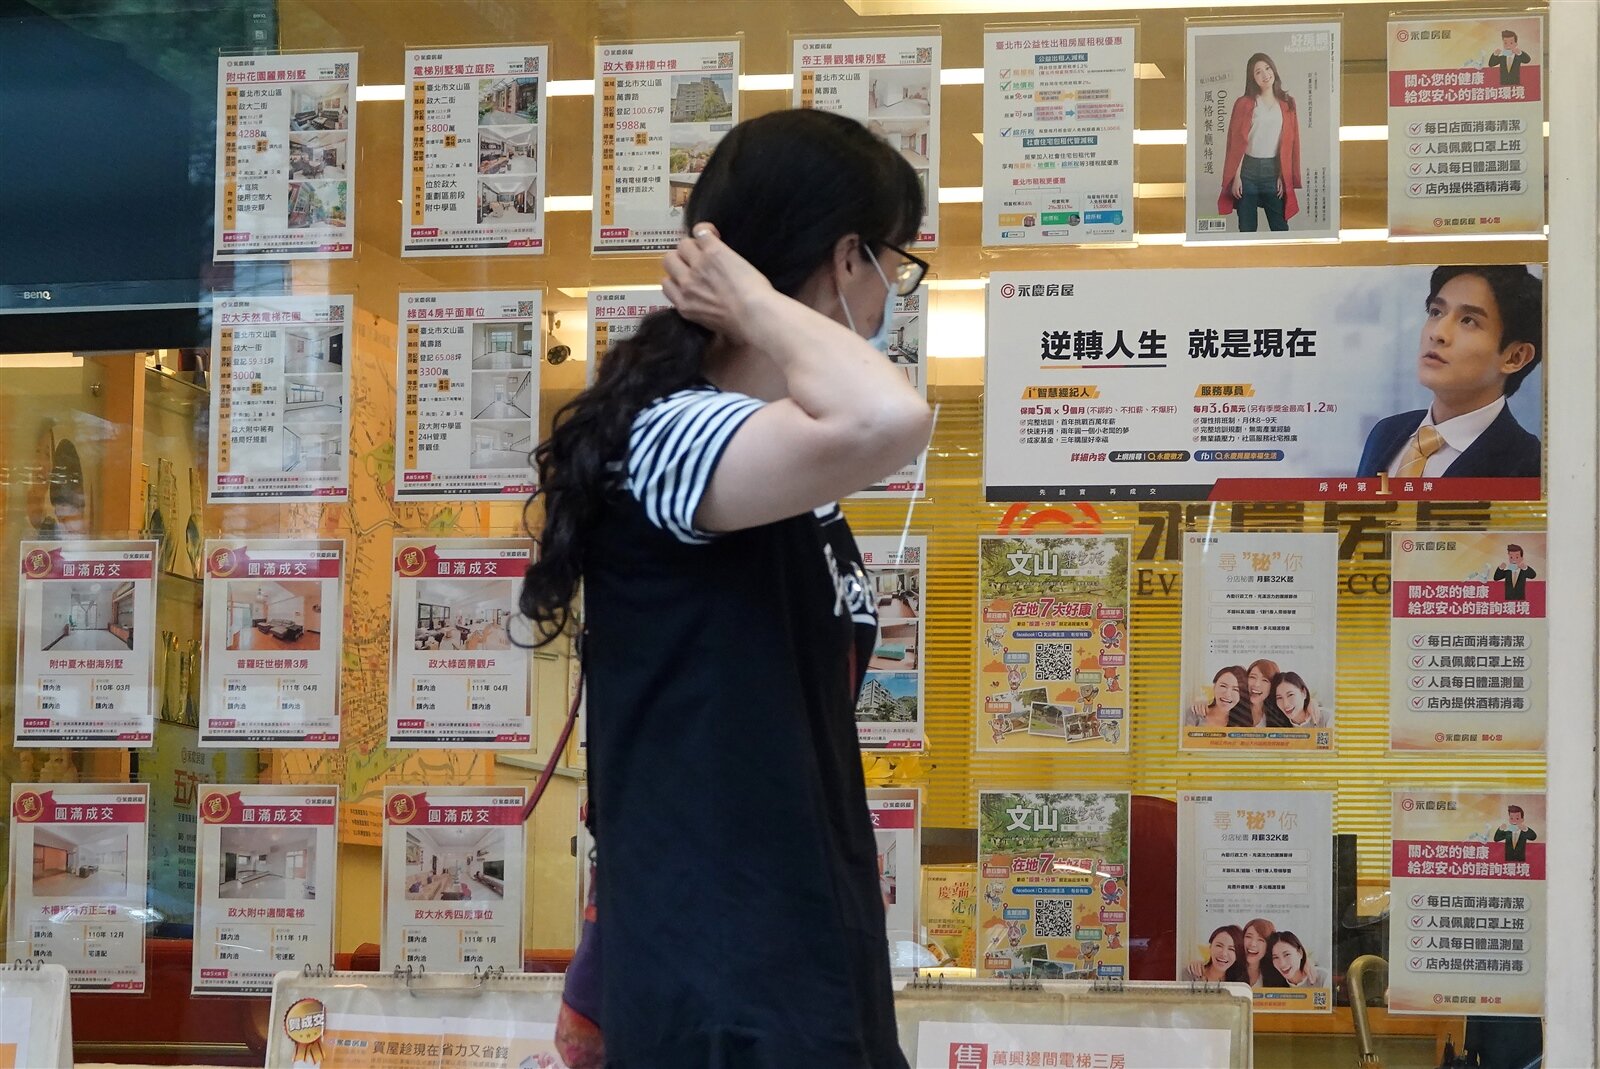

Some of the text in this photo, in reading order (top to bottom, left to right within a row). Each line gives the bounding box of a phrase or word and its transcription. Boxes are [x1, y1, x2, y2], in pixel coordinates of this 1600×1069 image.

[1410, 30, 1451, 40] 永慶房屋
[996, 36, 1122, 50] 臺北市公益性出租房屋租稅優惠
[802, 53, 886, 65] 帝王景觀獨棟別墅
[414, 64, 494, 76] 電梯別墅獨立庭院
[604, 60, 677, 71] 政大春耕樓中樓
[226, 70, 306, 82] 附中花園麗景別墅
[1404, 72, 1484, 87] 關心您的健康
[427, 83, 470, 92] 臺北市文山區
[617, 79, 662, 88] 臺北市文山區
[239, 88, 282, 98] 臺北市文山區
[1404, 86, 1526, 104] 給您安心的諮詢環境
[238, 102, 268, 110] 政大二街
[1217, 90, 1228, 132] Outdoor
[426, 124, 455, 132] 5800萬
[616, 121, 646, 130] 5988萬
[1424, 120, 1520, 134] 每日店面消毒清潔
[238, 129, 267, 138] 4288萬
[1203, 91, 1214, 174] 風格餐廳特選
[1426, 140, 1520, 154] 人員佩戴口罩上班
[1426, 160, 1520, 174] 人員每日體溫測量
[426, 180, 458, 188] 位於政大
[1426, 180, 1521, 194] 店內提供酒精消毒
[426, 192, 466, 200] 重劃區前段
[237, 204, 265, 212] 環境安靜
[425, 204, 457, 212] 附中學區
[24, 291, 51, 300] BenQ
[1018, 284, 1074, 298] 永慶房屋
[221, 311, 301, 323] 政大天然電梯花園
[408, 308, 485, 319] 綠茵4房平面車位
[420, 326, 464, 334] 臺北市文山區
[420, 340, 442, 348] 萬壽路
[1041, 328, 1317, 360] 逆轉人生 就是現在
[233, 371, 261, 380] 3000萬
[420, 368, 448, 376] 3300萬
[1202, 386, 1244, 396] 服務專員
[1020, 404, 1051, 415] 保障5萬
[231, 436, 267, 444] 格局好規劃
[1070, 453, 1106, 462] 詳細內容
[1201, 452, 1210, 460] fb
[1416, 542, 1456, 551] 永慶房屋
[32, 556, 120, 576] 賀 圓滿成交
[248, 562, 307, 576] 圓滿成交
[404, 552, 498, 575] 賀 圓滿成交
[1007, 550, 1058, 576] 文山
[1408, 586, 1489, 598] 關心您的健康
[1013, 598, 1092, 618] 在地7大好康
[1408, 602, 1530, 616] 給您安心的諮詢環境
[1428, 636, 1524, 647] 每日店面消毒清潔
[50, 659, 124, 670] 附中夏木樹海別墅
[237, 659, 308, 670] 普羅旺世樹景3房
[428, 659, 496, 670] 政大綠茵景觀戶
[1428, 656, 1524, 668] 人員佩戴口罩上班
[1428, 676, 1524, 688] 人員每日體溫測量
[1428, 697, 1524, 709] 店內提供酒精消毒
[22, 796, 114, 820] 賀 圓滿成交
[209, 798, 302, 822] 賀 圓滿成交
[394, 799, 490, 822] 賀 圓滿成交
[1416, 801, 1456, 810] 永慶房屋
[1006, 805, 1058, 832] 文山
[1408, 844, 1489, 859] 關心您的健康
[1408, 862, 1530, 877] 給您安心的諮詢環境
[1428, 896, 1524, 910] 每日店面消毒清潔
[228, 908, 304, 918] 政大附中邊間電梯
[415, 909, 493, 920] 政大水秀四房車位
[1427, 916, 1524, 930] 人員佩戴口罩上班
[1426, 936, 1524, 950] 人員每日體溫測量
[1426, 958, 1523, 972] 店內提供酒精消毒
[955, 1044, 1126, 1069] 售 萬興邊間電梯三房
